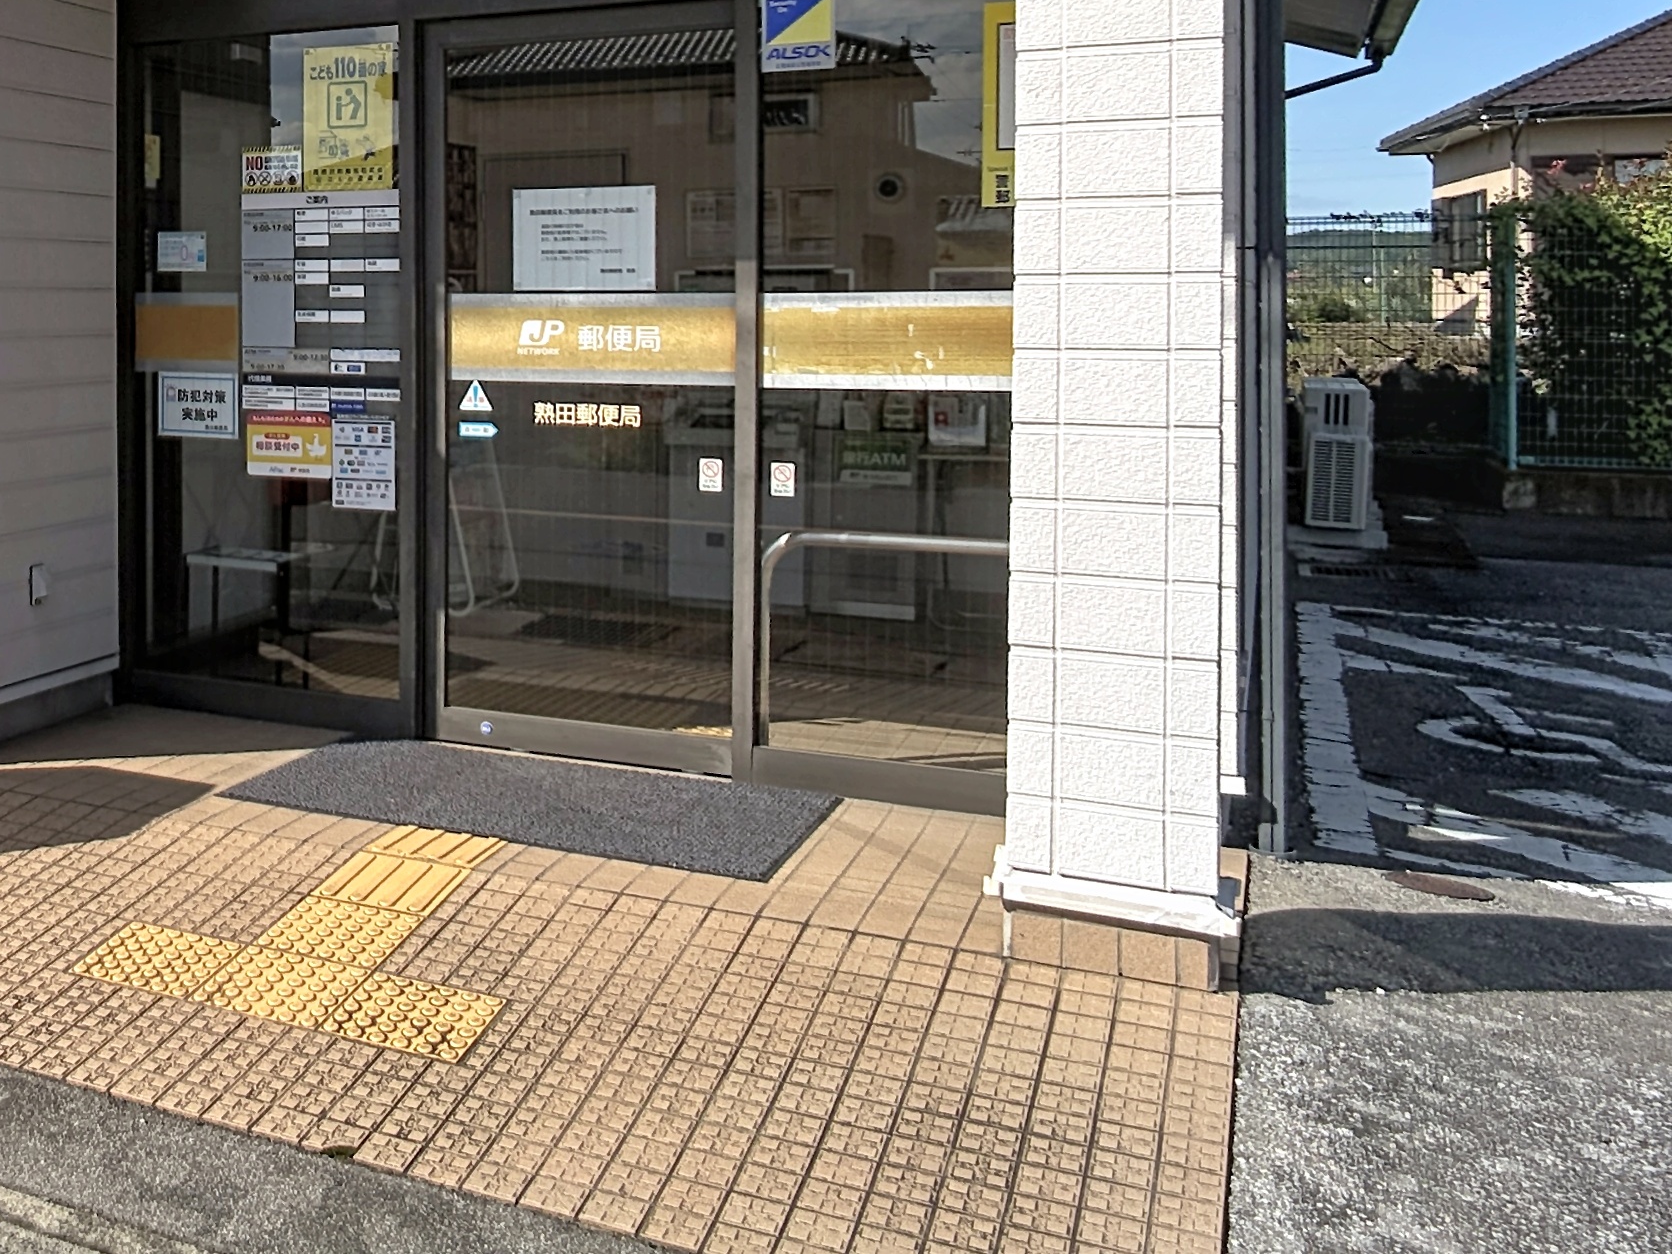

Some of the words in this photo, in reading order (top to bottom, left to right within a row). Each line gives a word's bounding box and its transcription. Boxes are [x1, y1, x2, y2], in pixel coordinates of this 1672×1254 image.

[766, 45, 831, 60] ALSOK
[245, 155, 264, 171] NO
[519, 319, 565, 346] JP
[578, 325, 661, 353] 郵便局
[516, 347, 561, 356] NETWORK
[177, 388, 227, 405] 防犯対策
[181, 407, 219, 422] 実施中
[532, 401, 643, 428] 熟田郵便局
